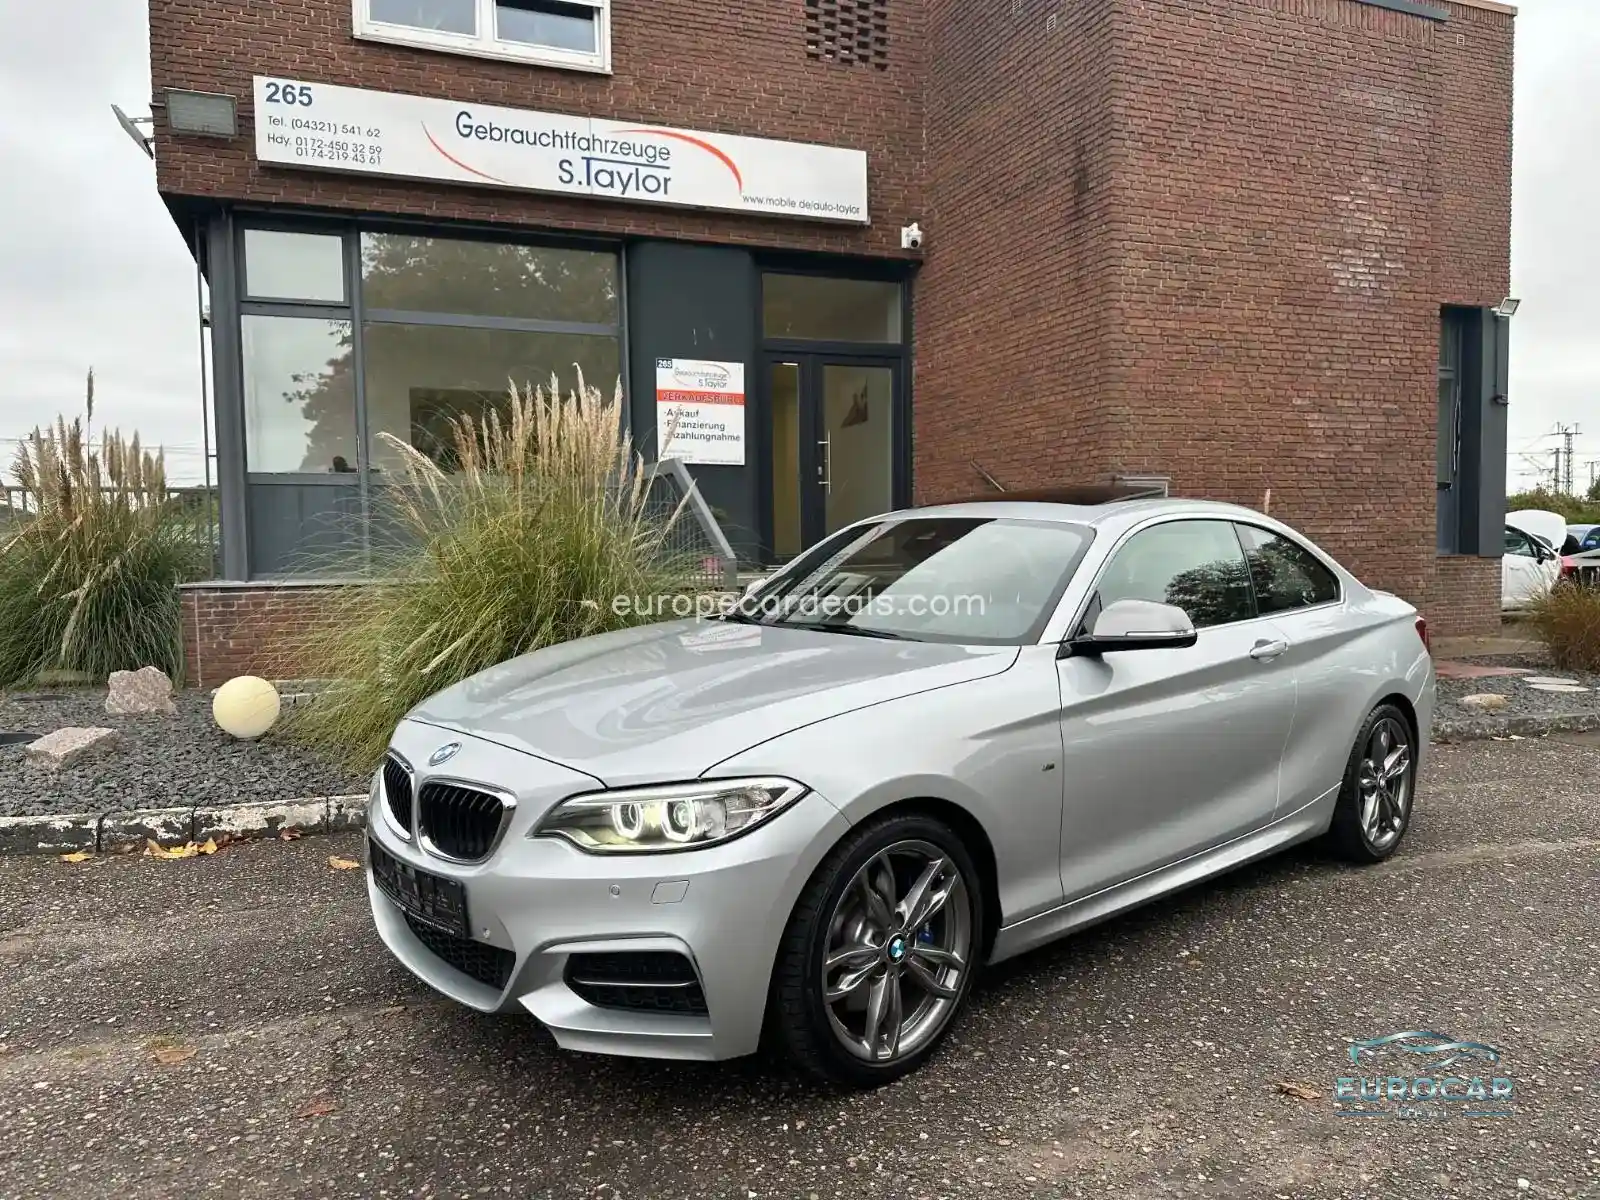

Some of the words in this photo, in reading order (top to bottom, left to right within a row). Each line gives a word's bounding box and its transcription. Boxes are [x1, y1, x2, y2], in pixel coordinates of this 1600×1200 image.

[265, 82, 313, 107] 265
[268, 115, 287, 127] Tel.
[291, 118, 337, 135] (04321)
[341, 124, 361, 136] 541
[366, 128, 381, 138] 62
[295, 136, 349, 152] 0172-450
[352, 143, 365, 154] 32
[369, 145, 382, 156] 59
[455, 110, 671, 163] Gebrauchtfahrzeuge
[296, 147, 349, 161] 0174-219
[352, 154, 366, 164] 43
[369, 155, 381, 166] 61
[558, 156, 672, 195] S.Taylor
[657, 359, 672, 369] 265
[666, 408, 700, 418] Akauf
[666, 419, 726, 432] Fnanzierung
[667, 431, 742, 443] nzahlungnahme
